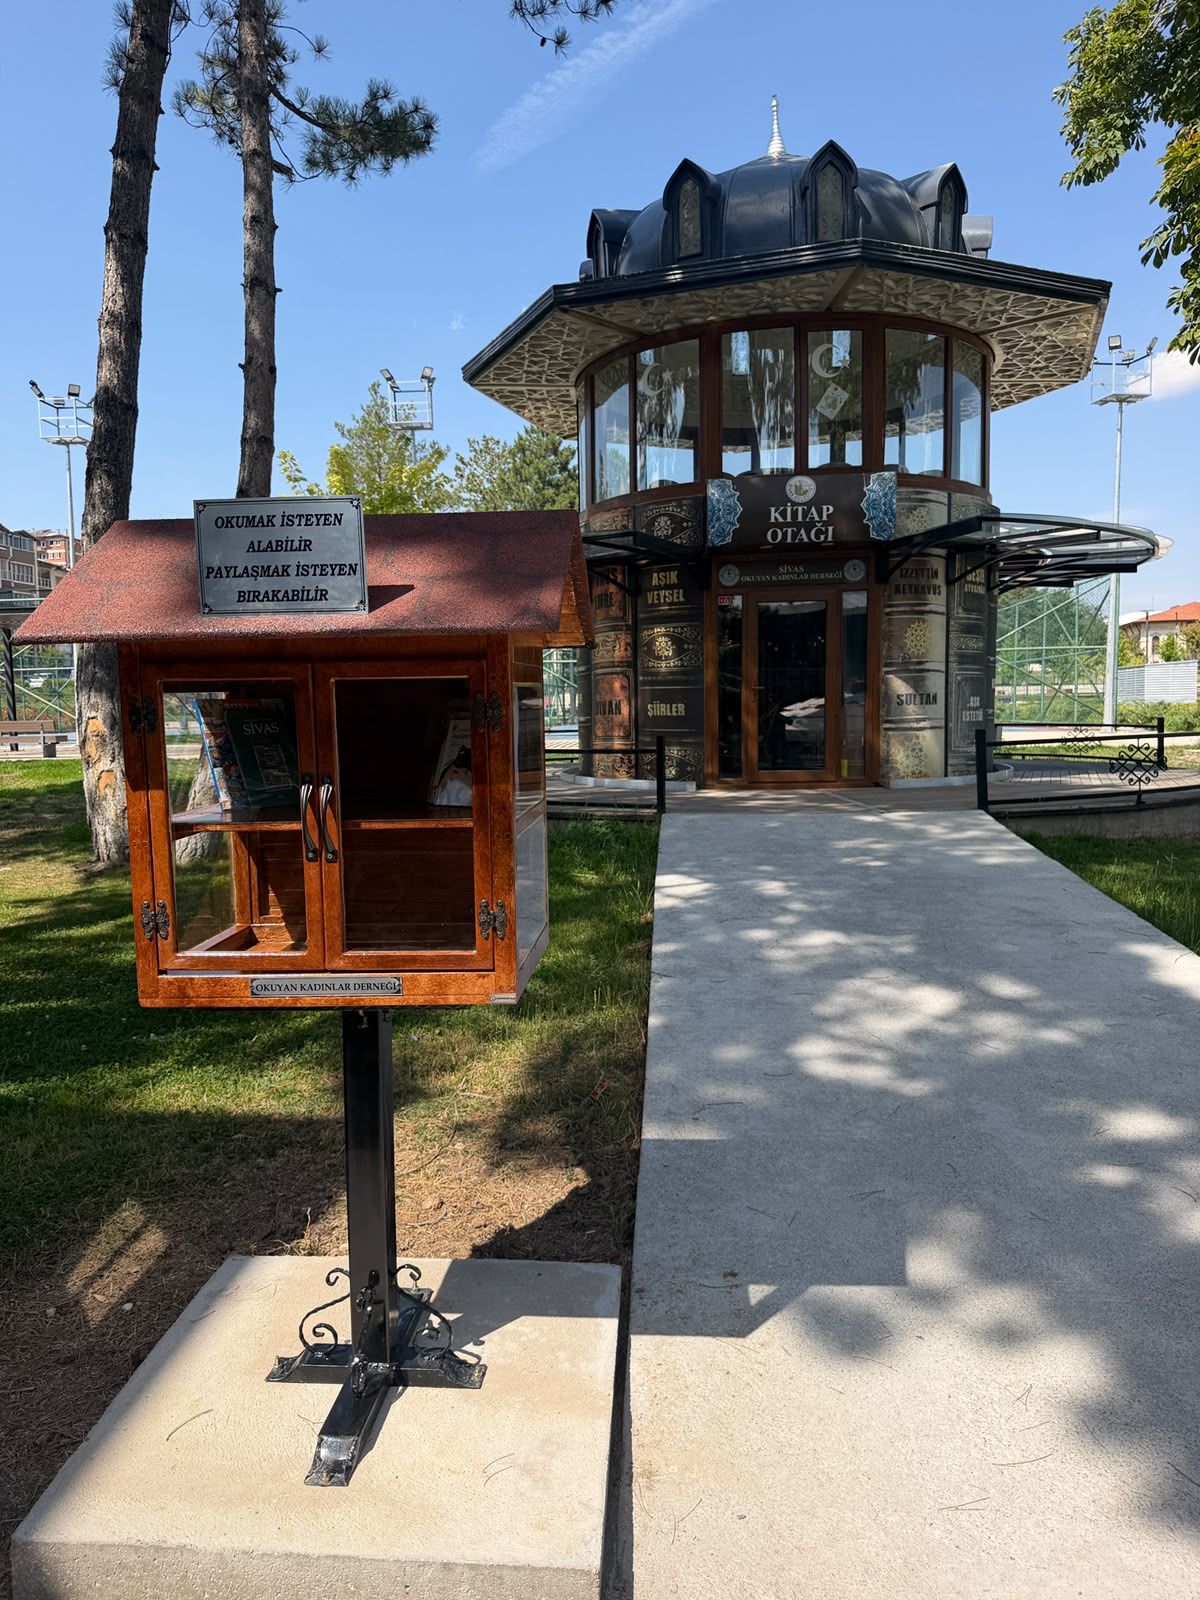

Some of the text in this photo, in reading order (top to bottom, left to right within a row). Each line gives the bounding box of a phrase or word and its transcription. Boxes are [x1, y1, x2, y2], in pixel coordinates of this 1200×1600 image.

[215, 511, 344, 529] OKUMAK İSTEYEN
[768, 502, 834, 523] KİTAP
[766, 522, 834, 544] OTAĞI
[246, 536, 313, 553] ALABİLİR
[205, 561, 359, 581] PAYLAŞMAK İSTEYEN
[651, 570, 679, 588] AŞIK
[236, 586, 329, 603] BIRAKABİLİR
[647, 588, 686, 605] VEYSEL
[896, 692, 937, 706] SULTAN
[647, 700, 686, 718] ŞİİRLER
[242, 721, 280, 736] SİVAS
[256, 981, 397, 992] OKUYAN KADINLAR DERNEĞİ
